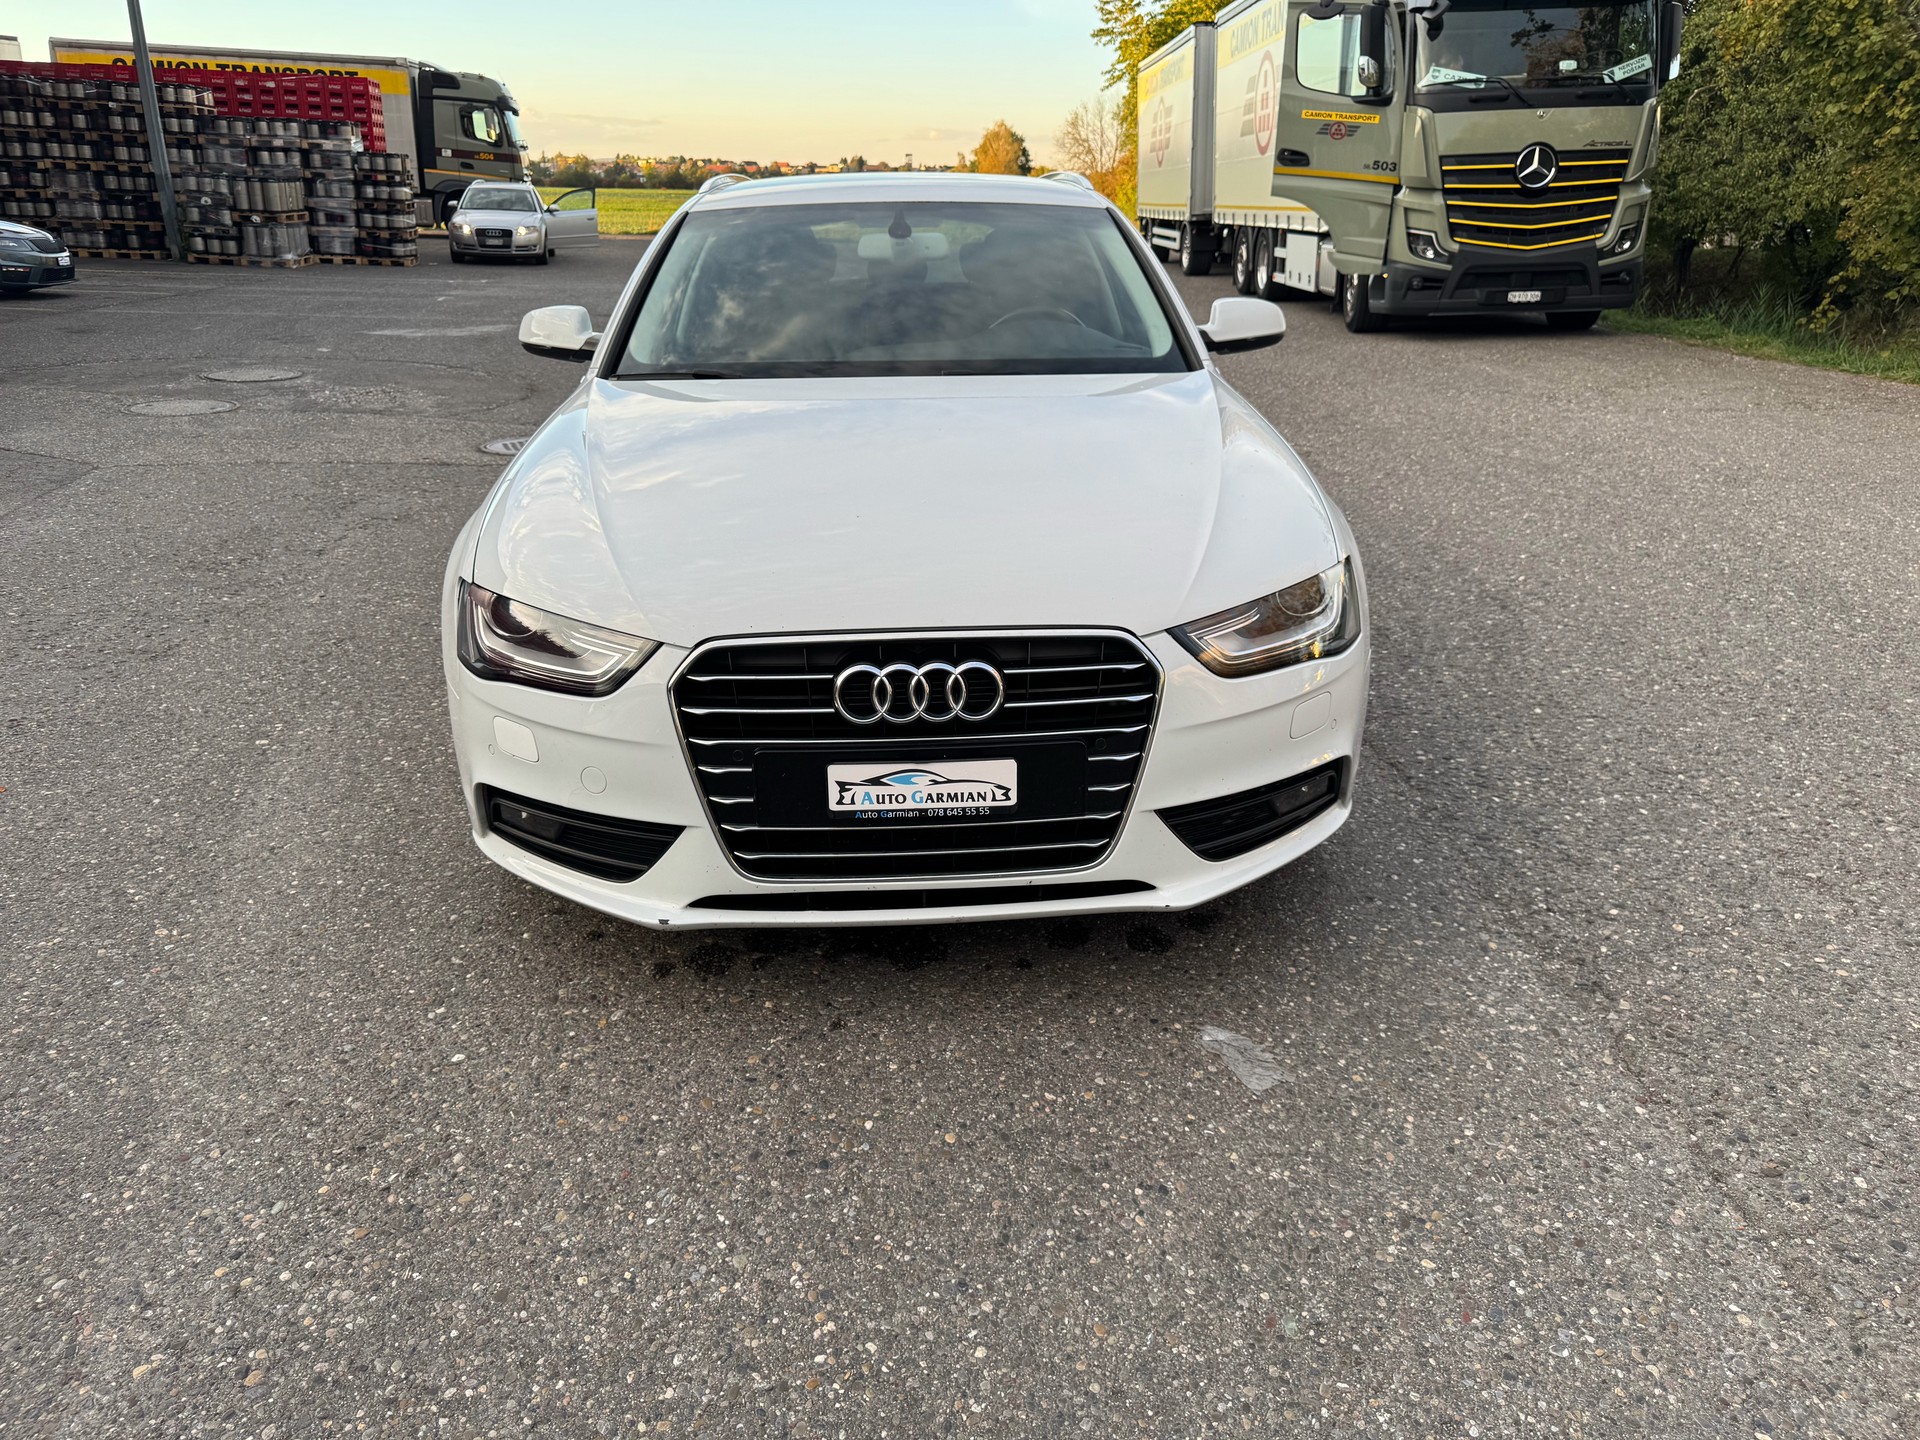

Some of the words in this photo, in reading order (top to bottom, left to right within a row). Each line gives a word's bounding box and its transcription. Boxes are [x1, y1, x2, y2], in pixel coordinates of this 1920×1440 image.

[1618, 56, 1647, 71] NERVOZNI
[1304, 111, 1333, 119] CAMION
[1335, 113, 1377, 122] TRANSPORT
[860, 791, 907, 805] AUTO
[911, 790, 987, 804] GARMIAN
[855, 811, 878, 819] Auto
[881, 810, 919, 818] Garmian
[927, 808, 945, 817] 078
[946, 808, 963, 816] 645
[965, 807, 977, 816] 55
[979, 806, 990, 815] 55
